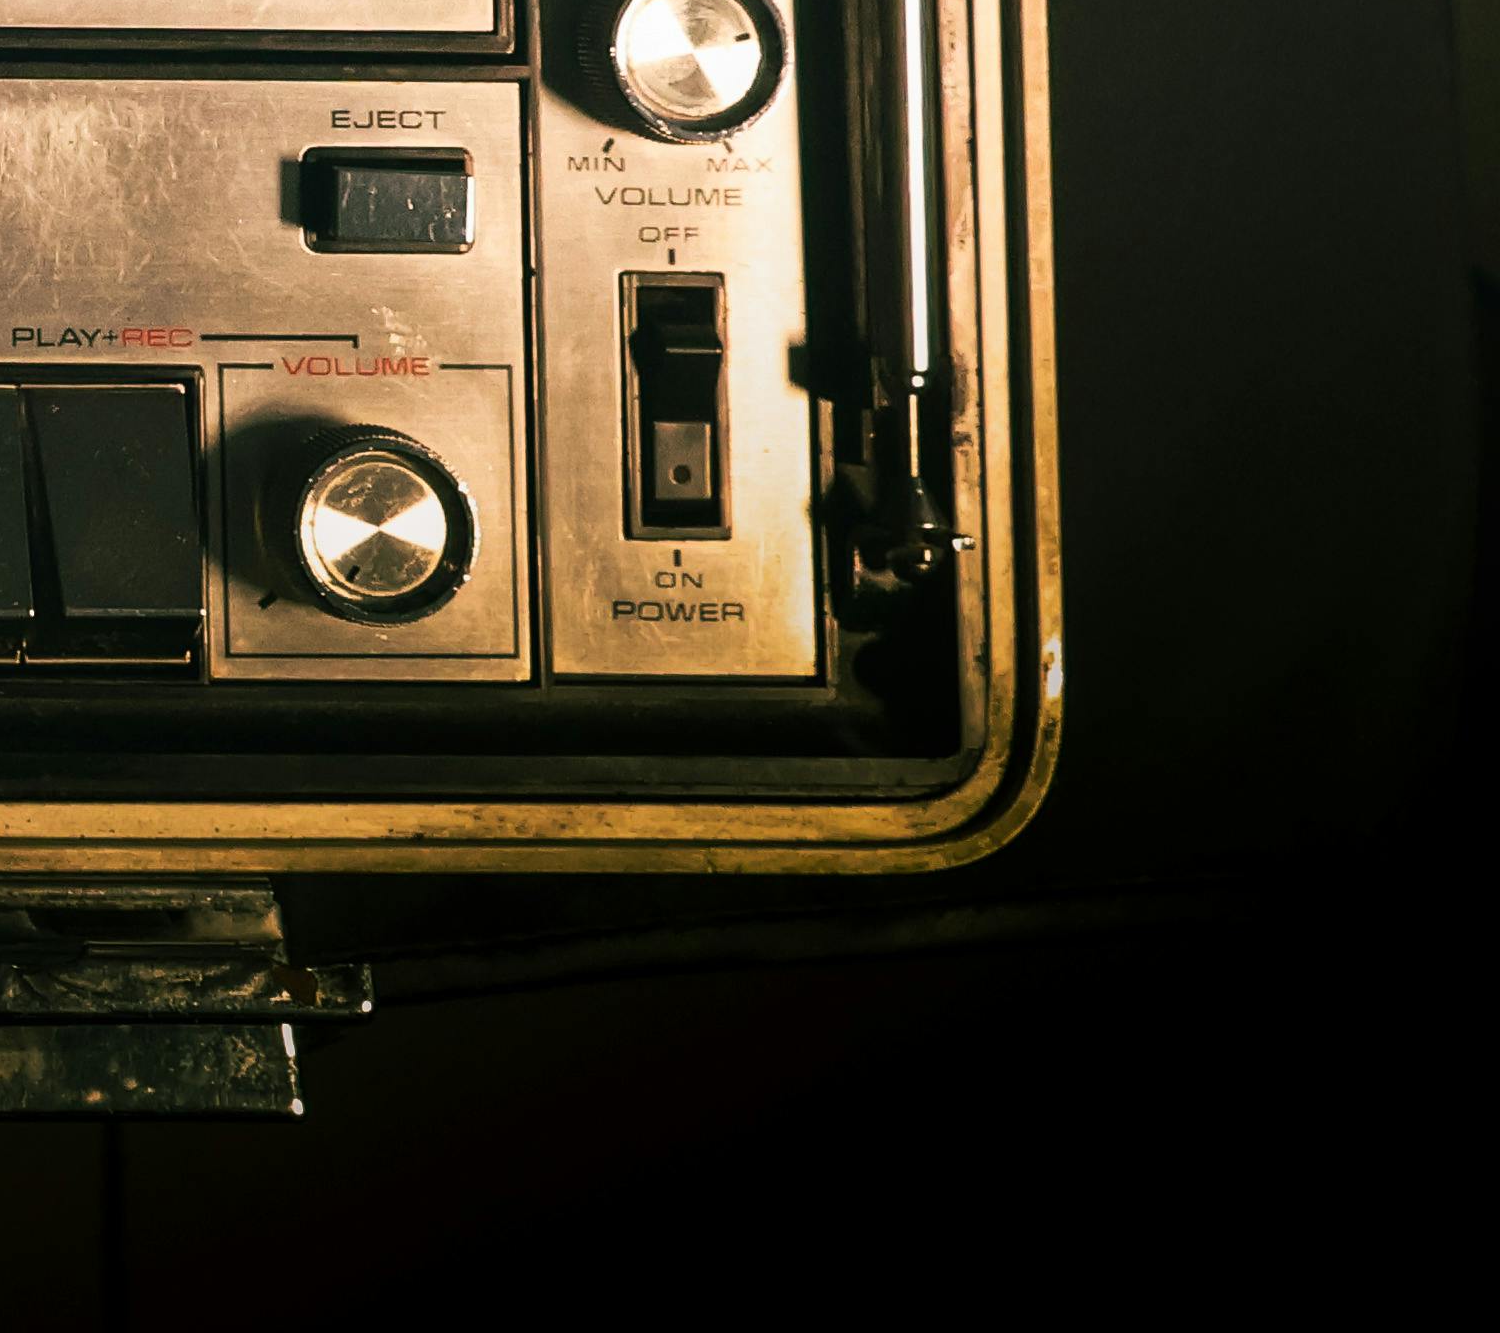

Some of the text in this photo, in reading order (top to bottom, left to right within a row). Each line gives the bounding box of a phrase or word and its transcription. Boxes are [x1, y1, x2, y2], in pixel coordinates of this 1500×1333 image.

[330, 110, 446, 129] EJECT
[567, 155, 626, 173] MIN
[706, 156, 773, 173] MAX
[594, 186, 744, 207] VOLUME
[638, 226, 700, 244] OFF
[281, 356, 430, 376] VOLUME
[654, 571, 703, 589] ON
[611, 601, 745, 622] POWER
